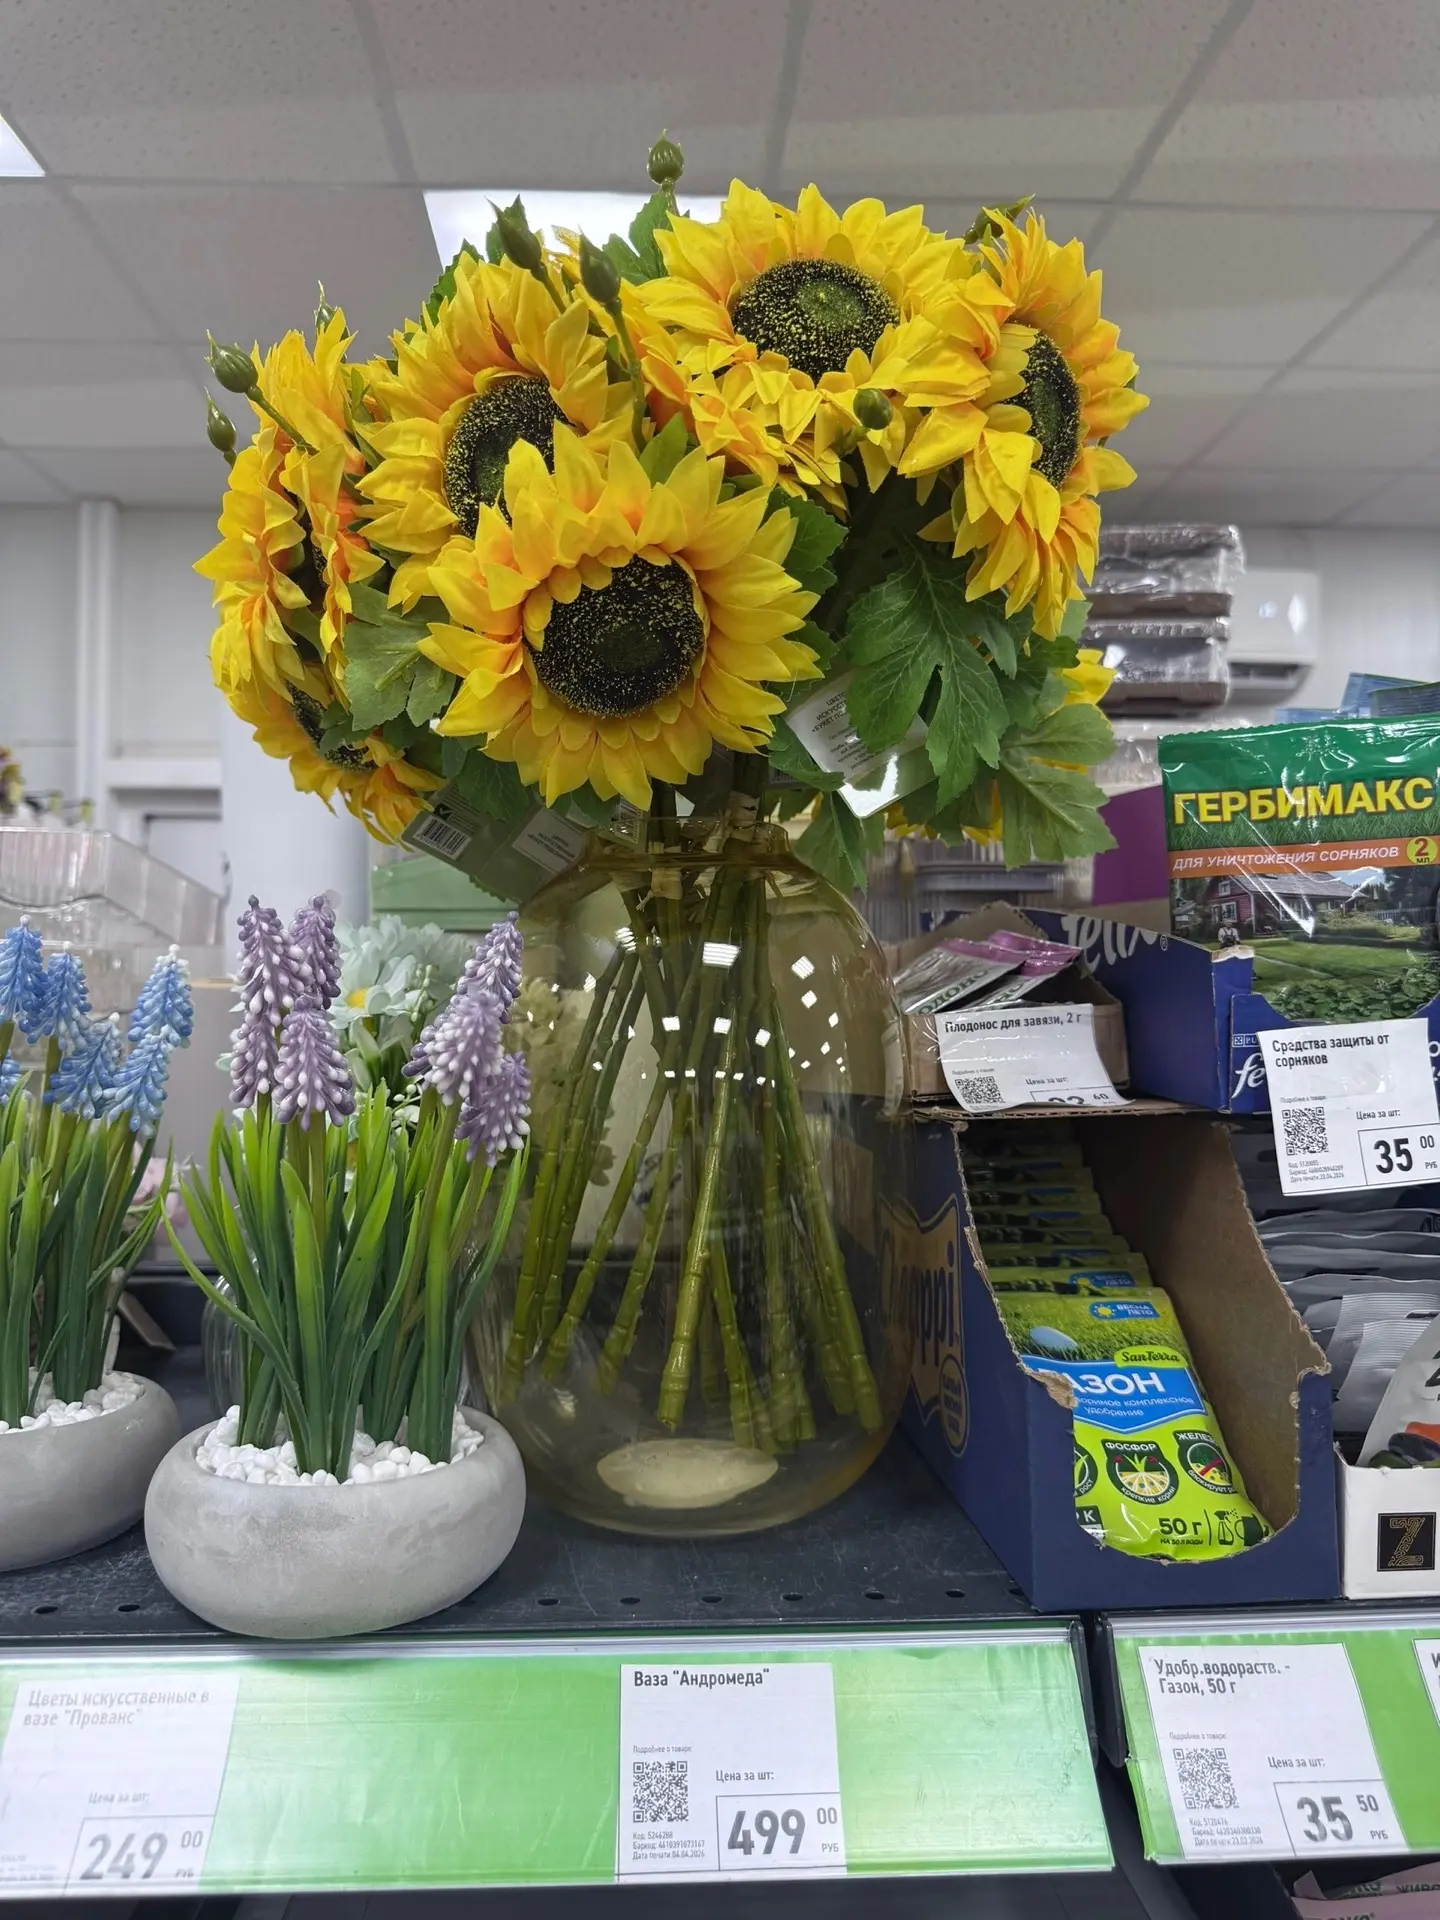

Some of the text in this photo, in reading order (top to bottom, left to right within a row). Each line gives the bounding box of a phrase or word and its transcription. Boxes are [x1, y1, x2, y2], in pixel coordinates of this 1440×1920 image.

[1174, 777, 1434, 826] ГЕРБИМАКС
[1414, 838, 1430, 857] 2
[1173, 846, 1400, 871] ДЛЯ УНИЧТОЖЕНИЯ СОРНЯКОВ
[945, 1012, 1082, 1033] Плодонос для завязи, 2 г
[1272, 1034, 1390, 1055] Средства защиты от
[1275, 1054, 1328, 1070] сорняков
[1356, 1109, 1401, 1121] Цена за шт:
[1420, 1135, 1436, 1149] 00
[1373, 1138, 1413, 1174] 35
[1425, 1161, 1438, 1170] РУБ
[1128, 1309, 1154, 1317] ЛЕТО
[1121, 1351, 1180, 1363] SanTerra
[1038, 1368, 1165, 1396] АЗОН
[1078, 1396, 1195, 1407] оримое комплексное
[1084, 1406, 1144, 1417] удобрение
[1105, 1441, 1157, 1452] ФОСФОР
[1079, 1478, 1094, 1494] рост
[1121, 1486, 1156, 1504] крепкие
[1159, 1517, 1202, 1535] 50 г
[634, 1668, 770, 1689] Ваза "Андромеда"
[1159, 1678, 1237, 1695] Газон, 50 г
[28, 1690, 210, 1708] Цветы искусственные в
[23, 1709, 143, 1730] вазе "Прованс"
[1268, 1757, 1326, 1769] Цена за шт:
[716, 1770, 775, 1782] Цена за шт:
[89, 1792, 115, 1804] Цена
[1356, 1795, 1379, 1812] 50
[817, 1807, 838, 1825] 00
[1297, 1796, 1354, 1843] 35
[180, 1830, 204, 1849] 00
[727, 1808, 805, 1856] 499
[1370, 1829, 1389, 1840] РУБ
[80, 1832, 168, 1880] 249
[822, 1843, 840, 1853] РУБ
